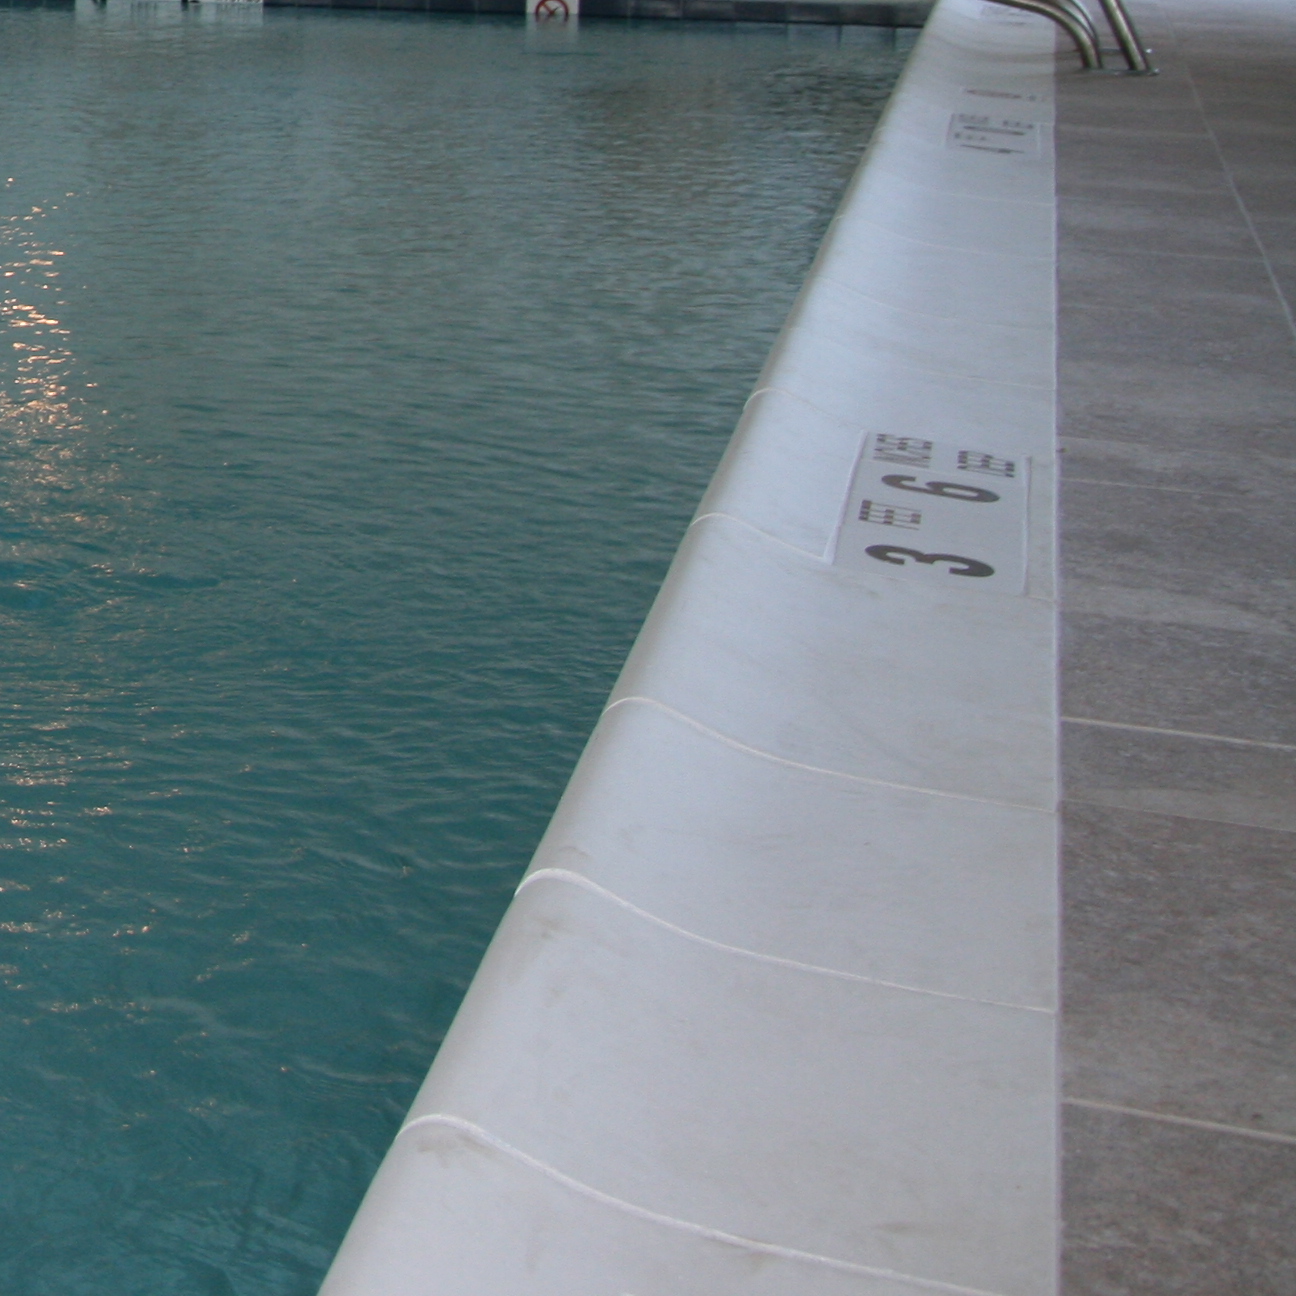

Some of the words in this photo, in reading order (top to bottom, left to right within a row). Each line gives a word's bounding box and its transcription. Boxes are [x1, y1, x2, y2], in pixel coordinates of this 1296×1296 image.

[881, 474, 1000, 503] 6
[858, 498, 922, 530] FEET
[864, 544, 996, 578] 3
